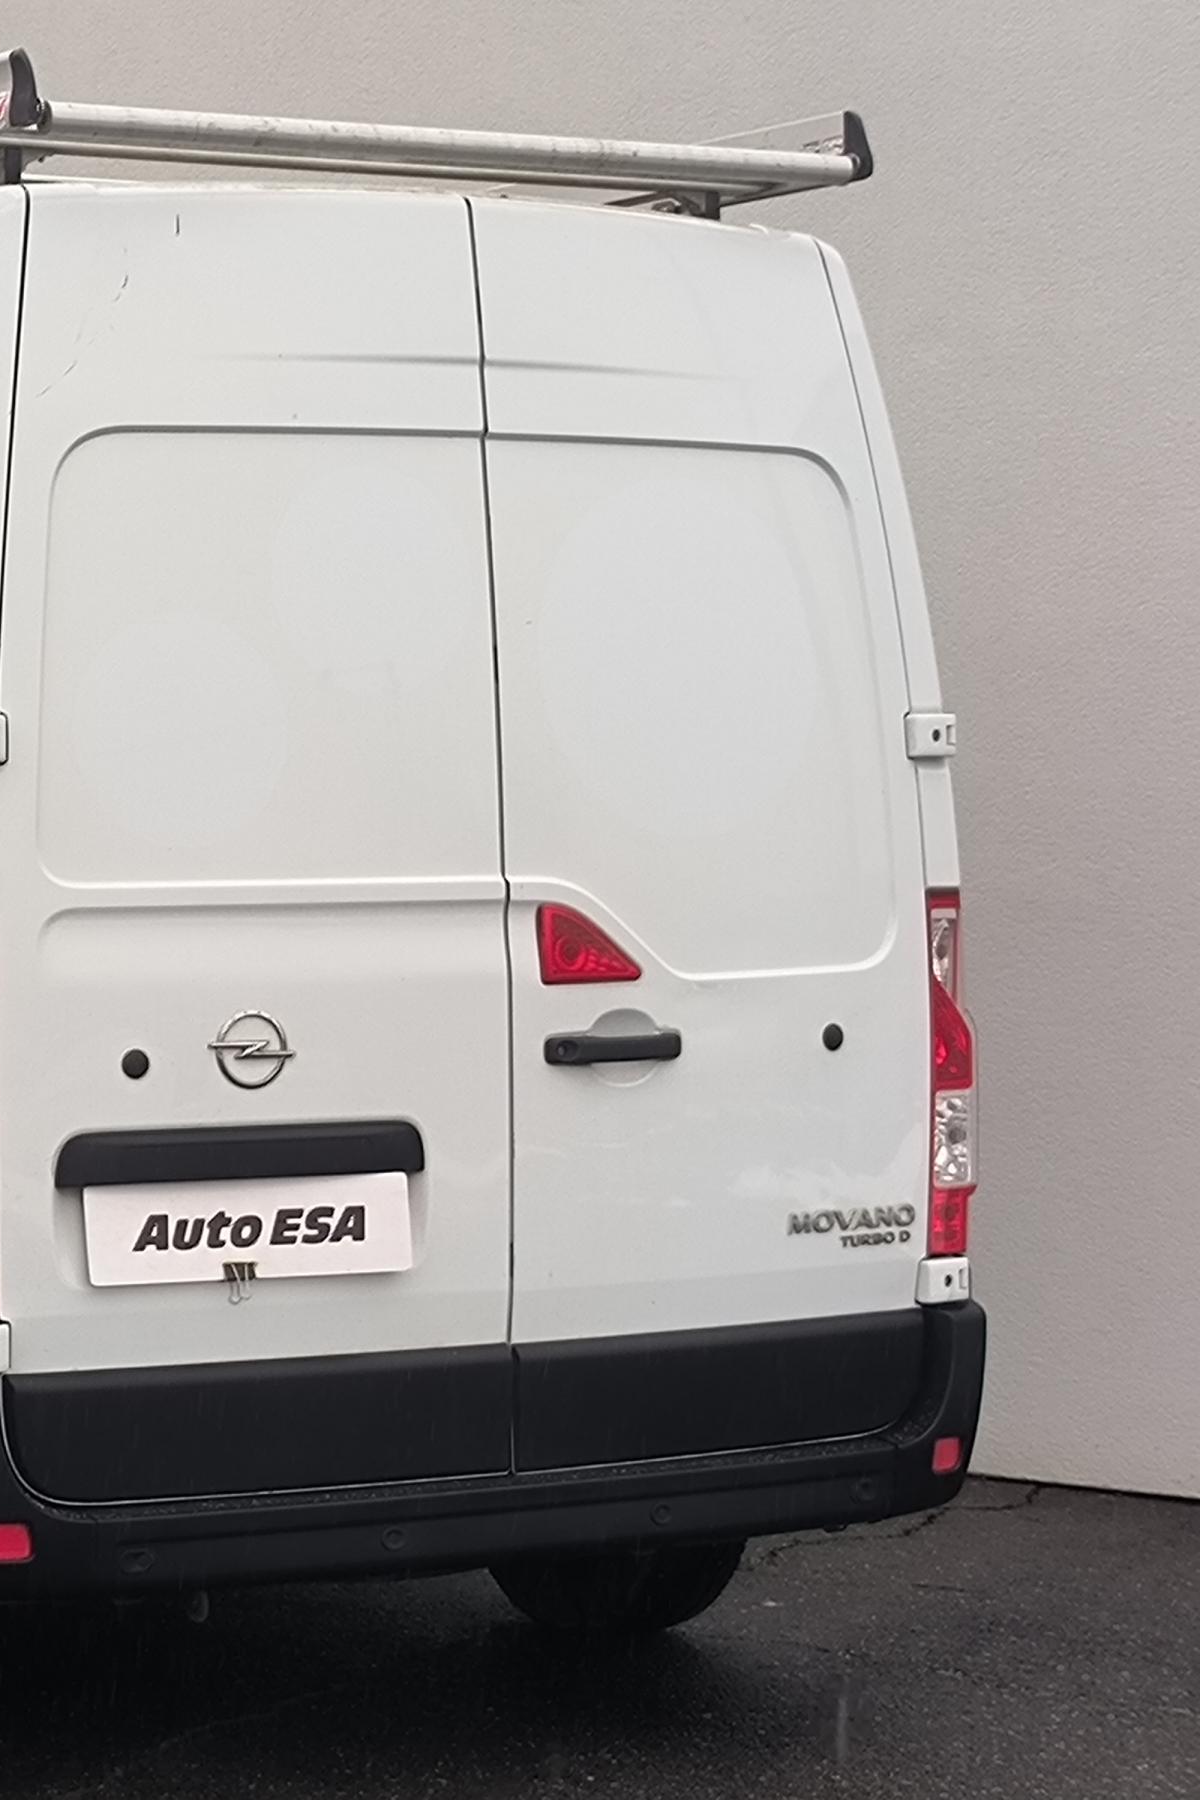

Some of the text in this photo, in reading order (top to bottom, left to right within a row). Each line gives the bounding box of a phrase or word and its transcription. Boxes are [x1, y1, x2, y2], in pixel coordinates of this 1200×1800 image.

[133, 1206, 365, 1252] Auto ESA
[788, 1204, 915, 1235] MOVANO
[840, 1230, 911, 1247] TURBO D
